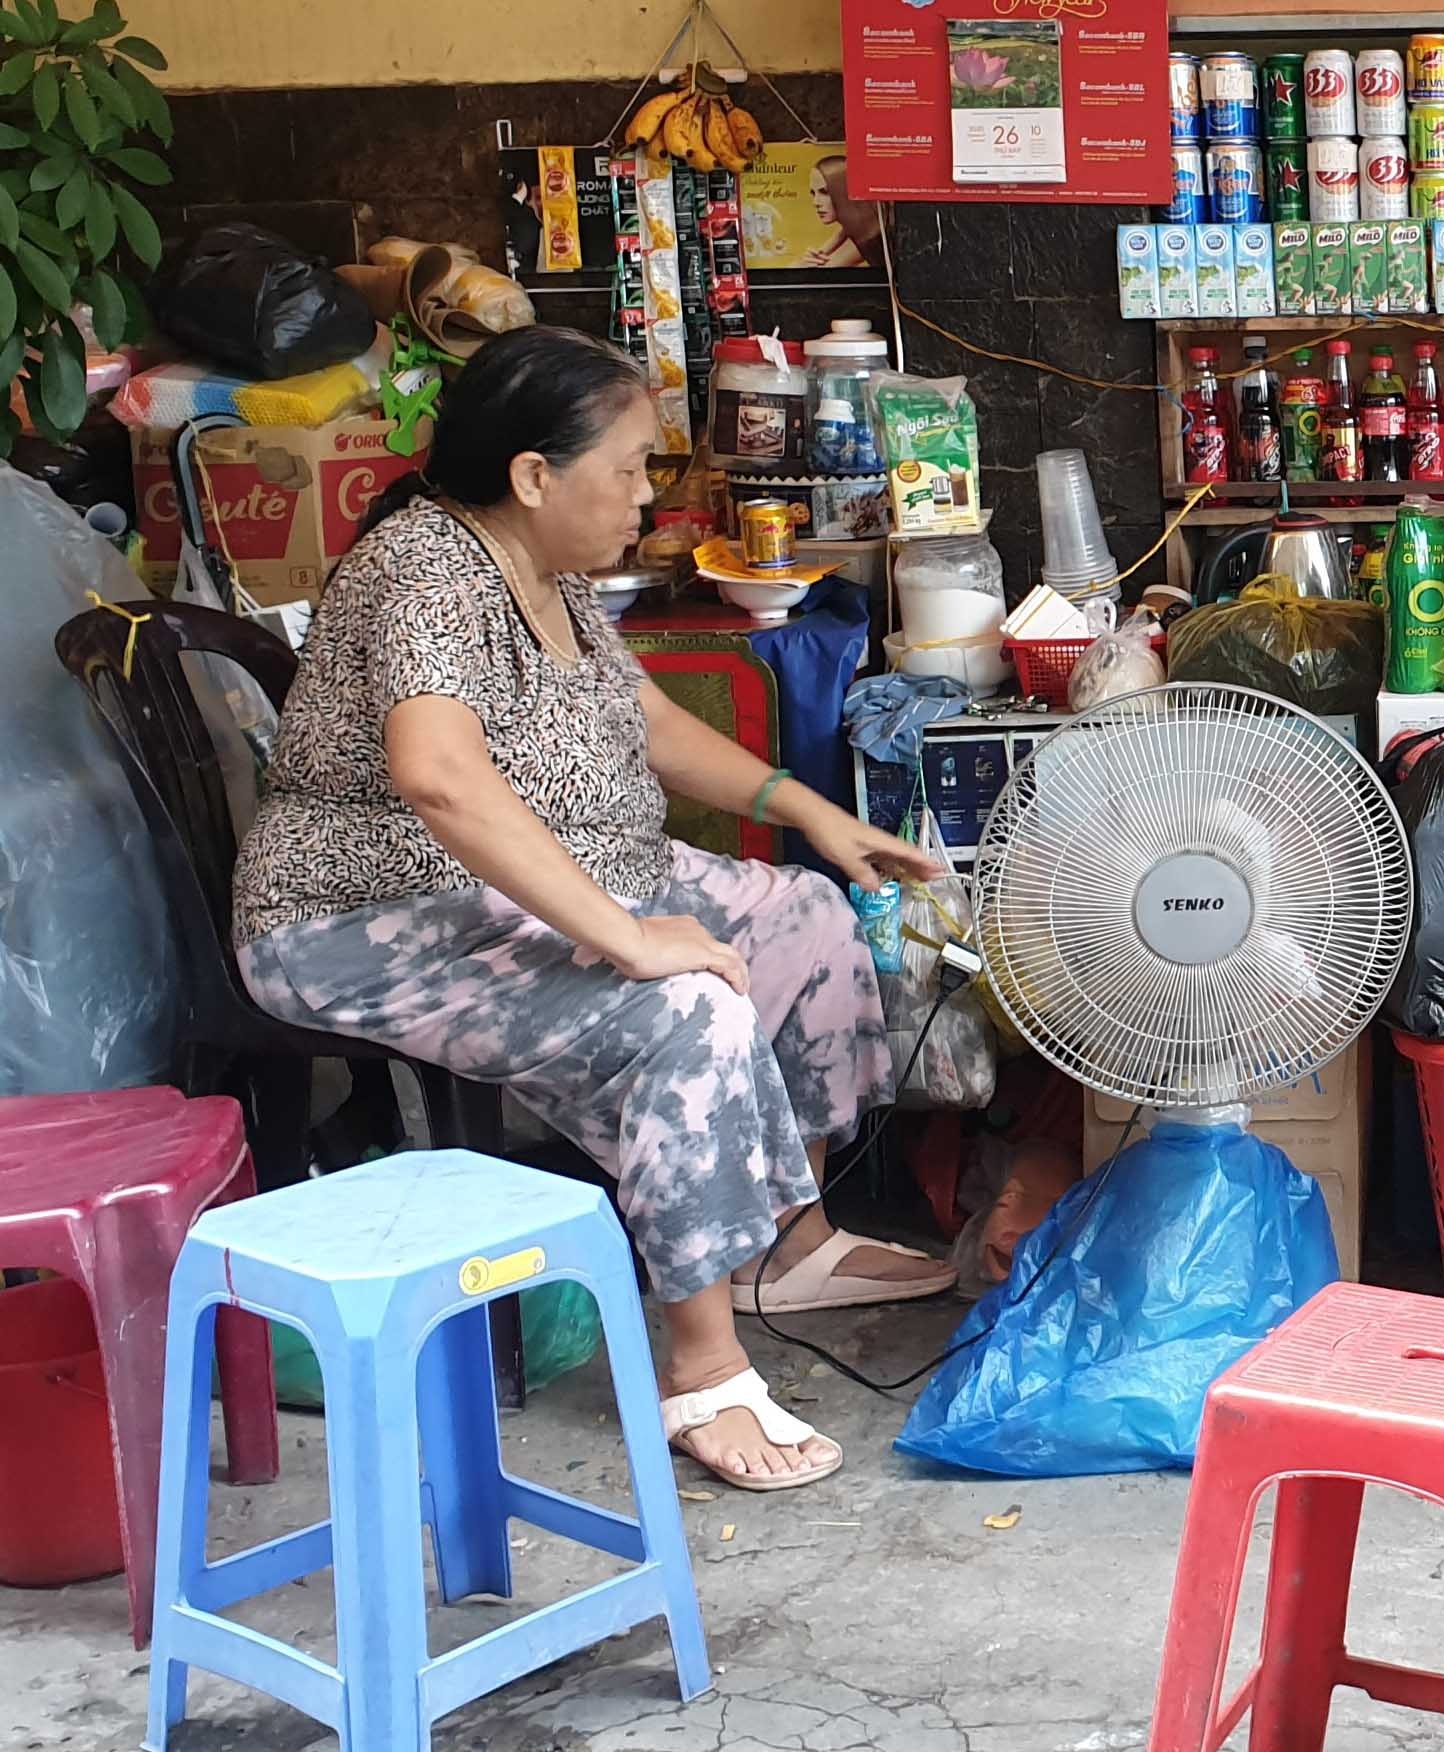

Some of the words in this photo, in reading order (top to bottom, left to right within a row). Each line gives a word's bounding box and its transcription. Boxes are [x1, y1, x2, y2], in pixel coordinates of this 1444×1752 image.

[992, 125, 1019, 144] 26
[1282, 233, 1305, 244] MILO
[1319, 232, 1343, 244] MILO
[1357, 231, 1381, 242] MILO
[1393, 230, 1417, 241] MILO
[353, 434, 385, 449] ORIO
[1162, 897, 1225, 912] SENKO
